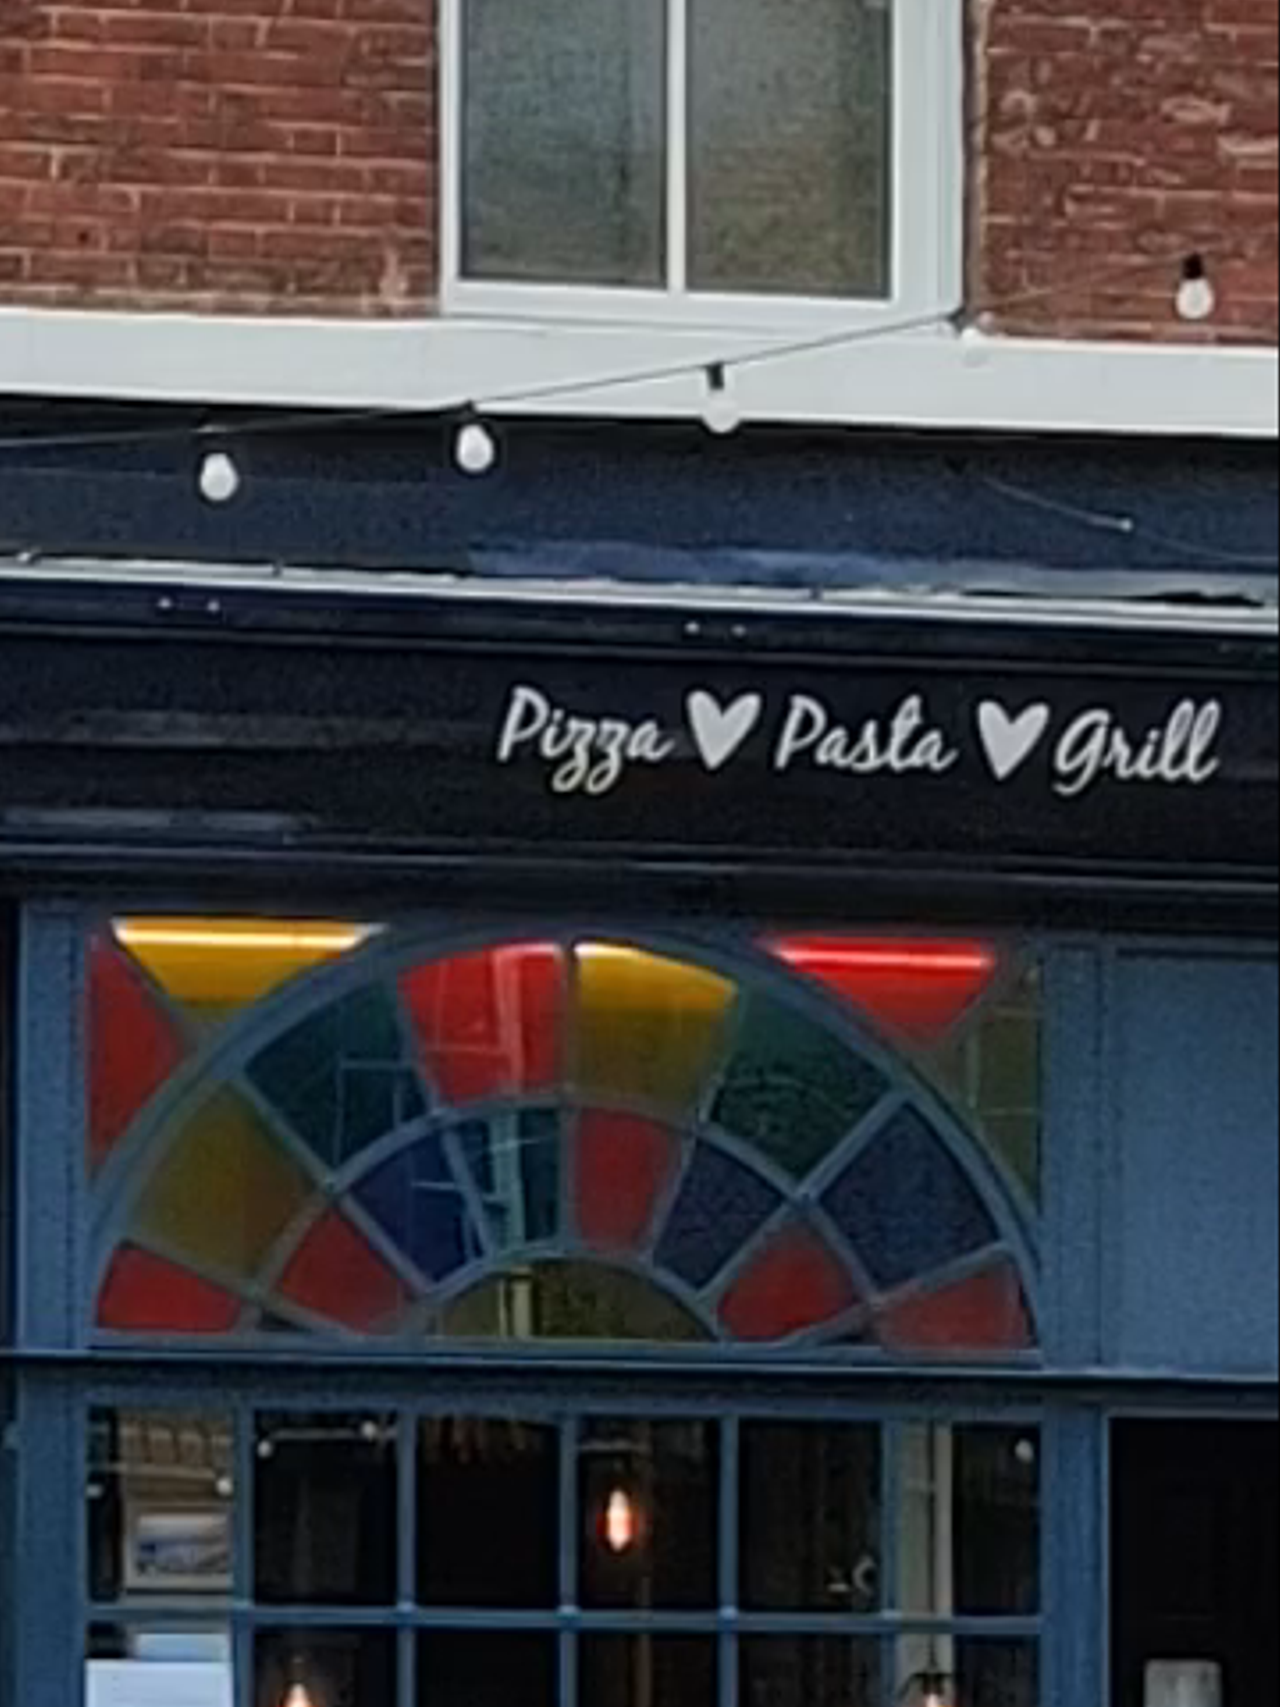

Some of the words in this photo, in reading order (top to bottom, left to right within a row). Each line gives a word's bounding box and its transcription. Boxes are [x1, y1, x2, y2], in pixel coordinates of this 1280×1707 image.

[498, 686, 675, 794] Pizza
[774, 694, 958, 772] Pasta
[1054, 699, 1220, 795] Grill
